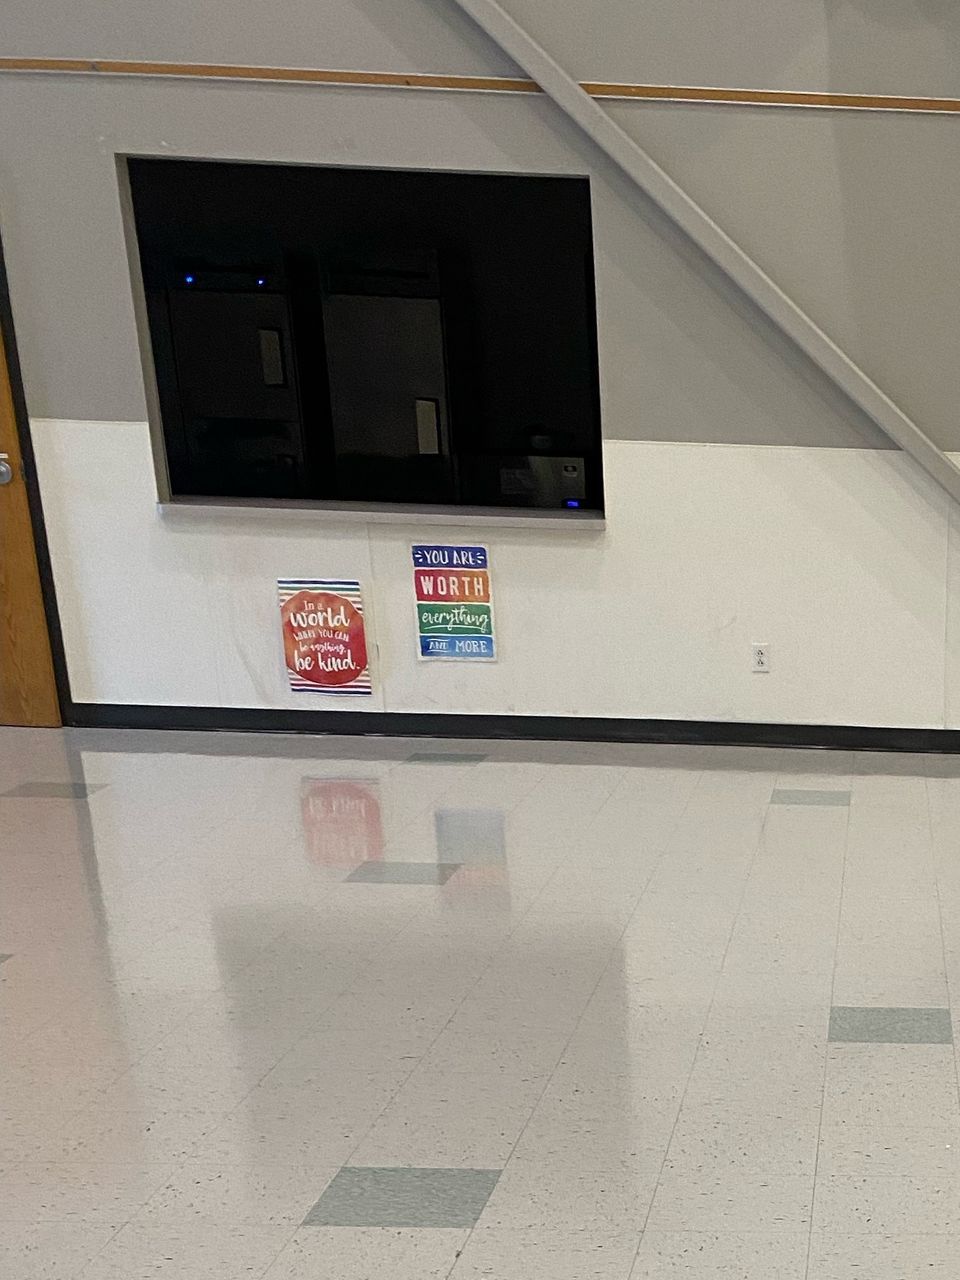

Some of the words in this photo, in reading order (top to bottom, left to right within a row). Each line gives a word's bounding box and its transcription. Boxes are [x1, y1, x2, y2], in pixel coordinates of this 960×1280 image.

[423, 550, 449, 565] YOU
[453, 550, 476, 565] ARE
[420, 575, 484, 596] WORTH
[304, 601, 315, 611] In
[317, 602, 324, 610] a
[290, 606, 350, 627] world
[421, 605, 489, 633] everything
[318, 629, 333, 639] YOU
[334, 630, 349, 642] CAN
[428, 641, 449, 650] AND
[455, 640, 488, 653] MORE
[294, 649, 315, 671] be
[317, 649, 361, 672] kind.
